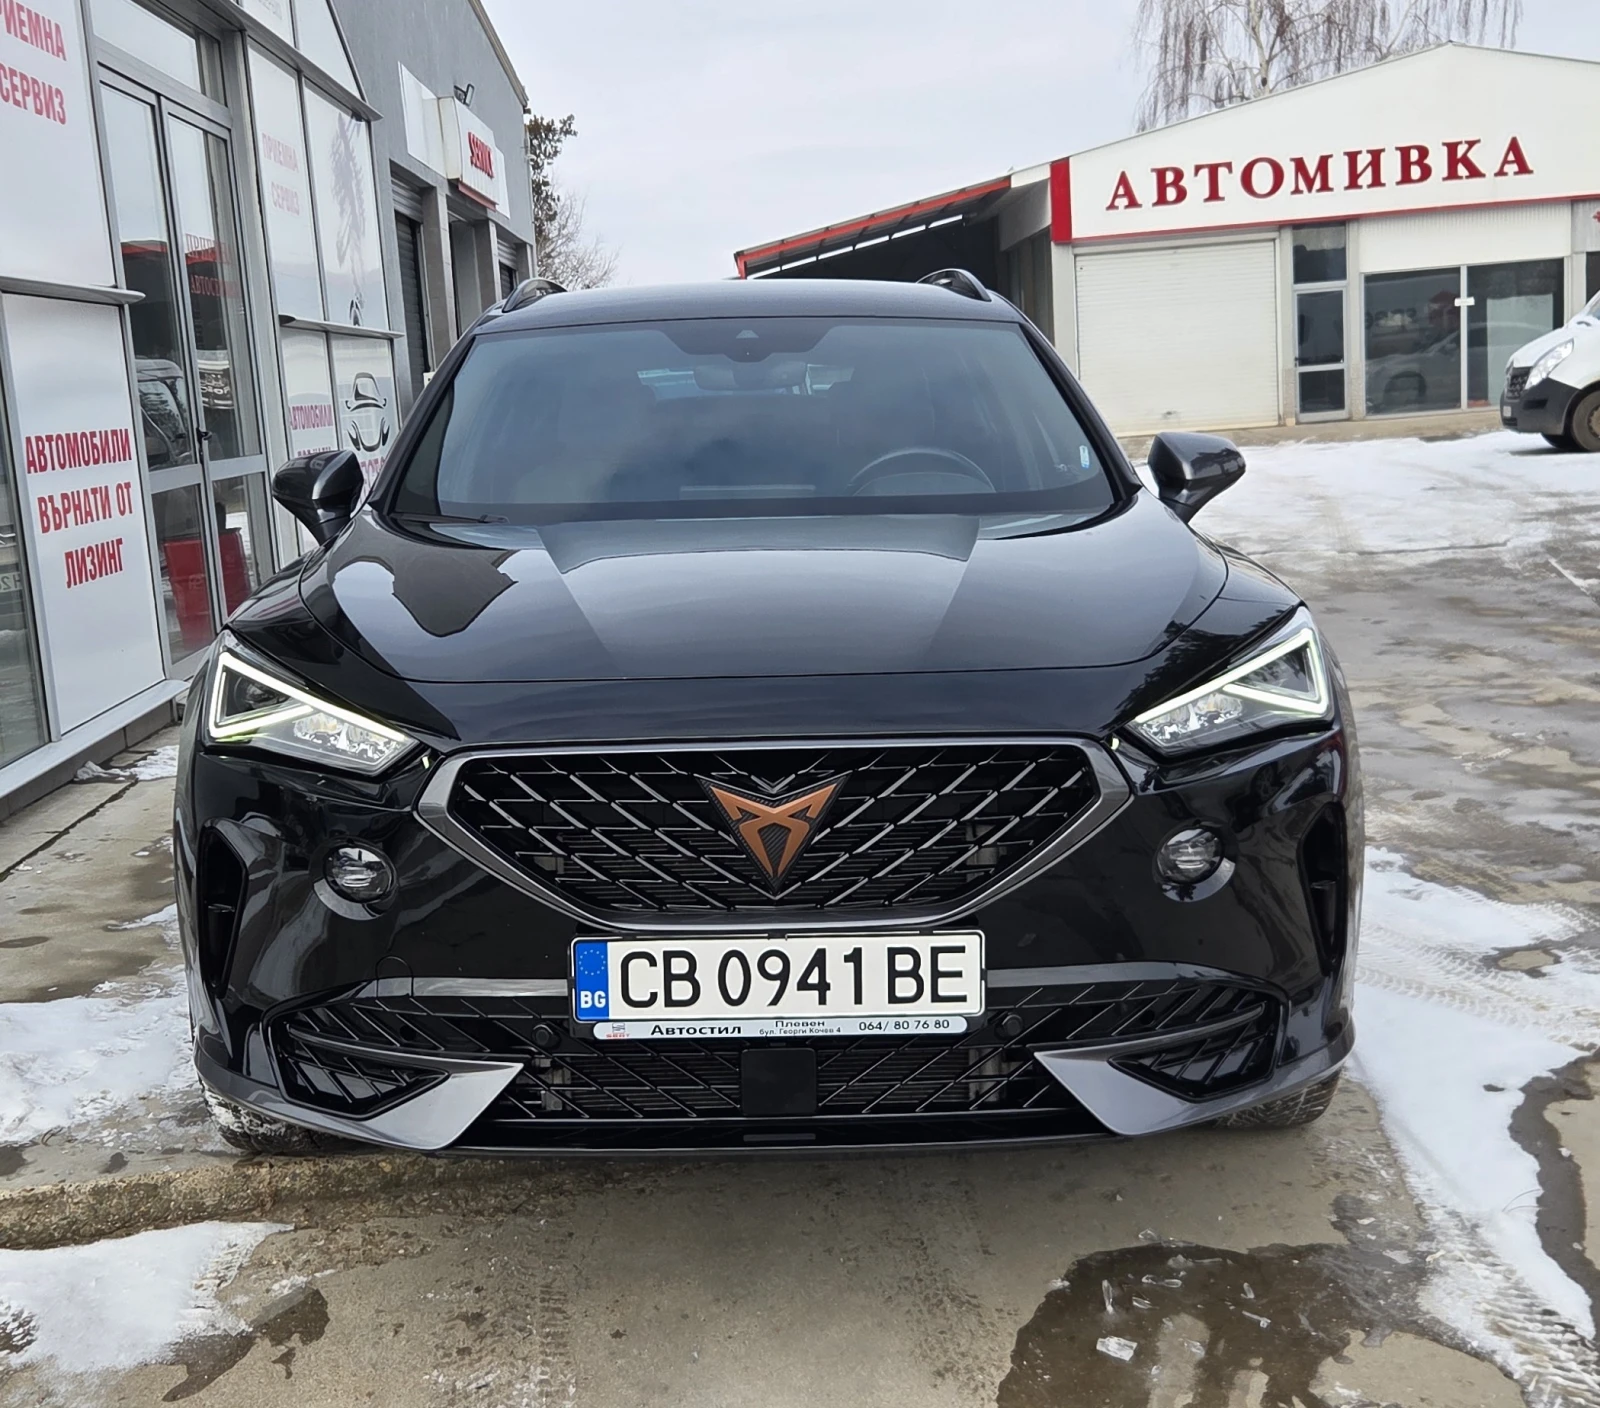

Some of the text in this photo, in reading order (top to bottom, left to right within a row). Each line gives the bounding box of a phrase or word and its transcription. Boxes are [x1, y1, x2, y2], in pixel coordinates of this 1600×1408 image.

[0, 0, 67, 61] ИЕМНА
[0, 62, 67, 125] СЕРВИЗ
[1105, 136, 1535, 211] АВТОМИВКА
[25, 428, 132, 475] АВТОМОБИЛИ
[37, 481, 133, 534] ВЪРНАТИ ОТ
[64, 537, 124, 589] ЛИЗИНГ
[580, 991, 606, 1008] BG
[620, 945, 968, 1009] CB 0941 BE
[650, 1024, 742, 1036] Автостил
[775, 1020, 825, 1028] Плевен
[858, 1019, 950, 1032] 064/ 80 76 80
